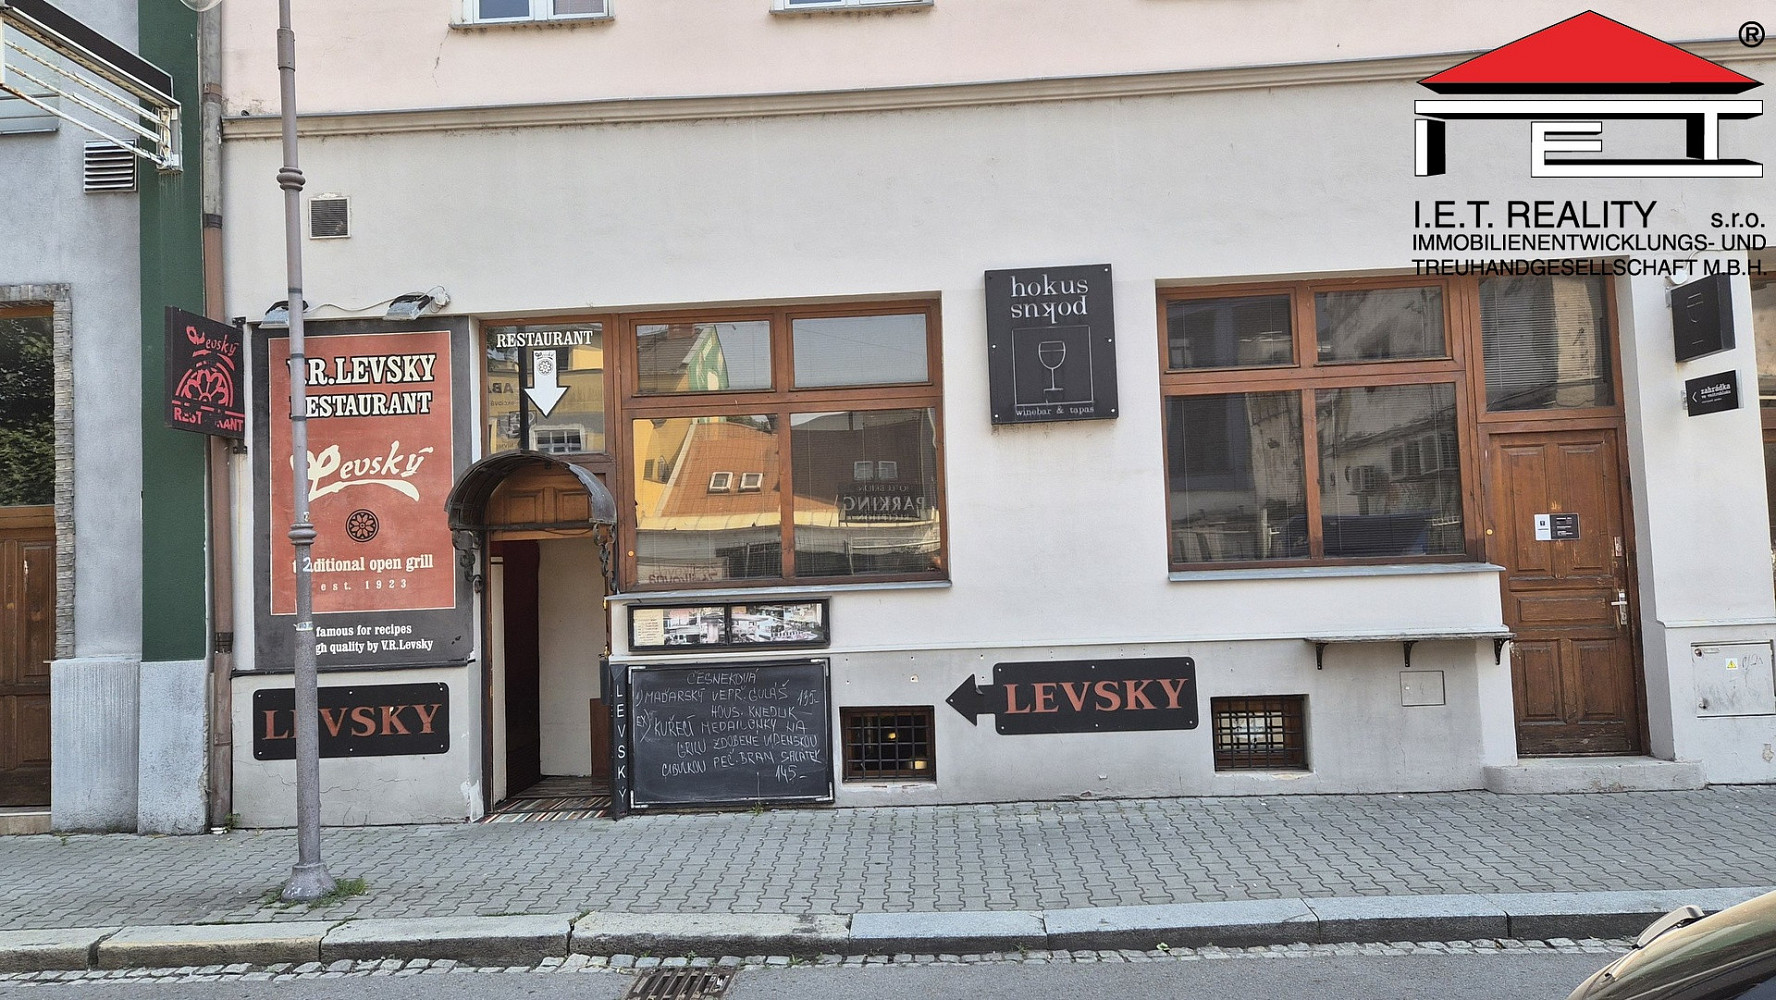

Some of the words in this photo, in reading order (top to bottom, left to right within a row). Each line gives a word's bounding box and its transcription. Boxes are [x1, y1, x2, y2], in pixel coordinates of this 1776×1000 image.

[1010, 274, 1089, 298] hokus
[496, 330, 593, 348] RESTAURANT
[287, 353, 437, 386] .R.LEVSKY
[290, 391, 434, 419] ESTAURANT
[1015, 404, 1052, 417] winebar
[1056, 405, 1064, 415] &
[1069, 404, 1095, 416] tapas
[292, 556, 365, 574] tditional
[369, 558, 403, 574] open
[405, 553, 434, 572] grill
[320, 581, 352, 592] est.
[364, 578, 408, 590] 1923
[316, 625, 354, 638] famous
[356, 624, 372, 637] for
[374, 623, 412, 637] recipes
[329, 639, 366, 654] quality
[366, 641, 379, 653] by
[380, 638, 434, 652] V.R.Levsky
[1003, 678, 1189, 715] LEVSKY
[786, 719, 809, 736] NA
